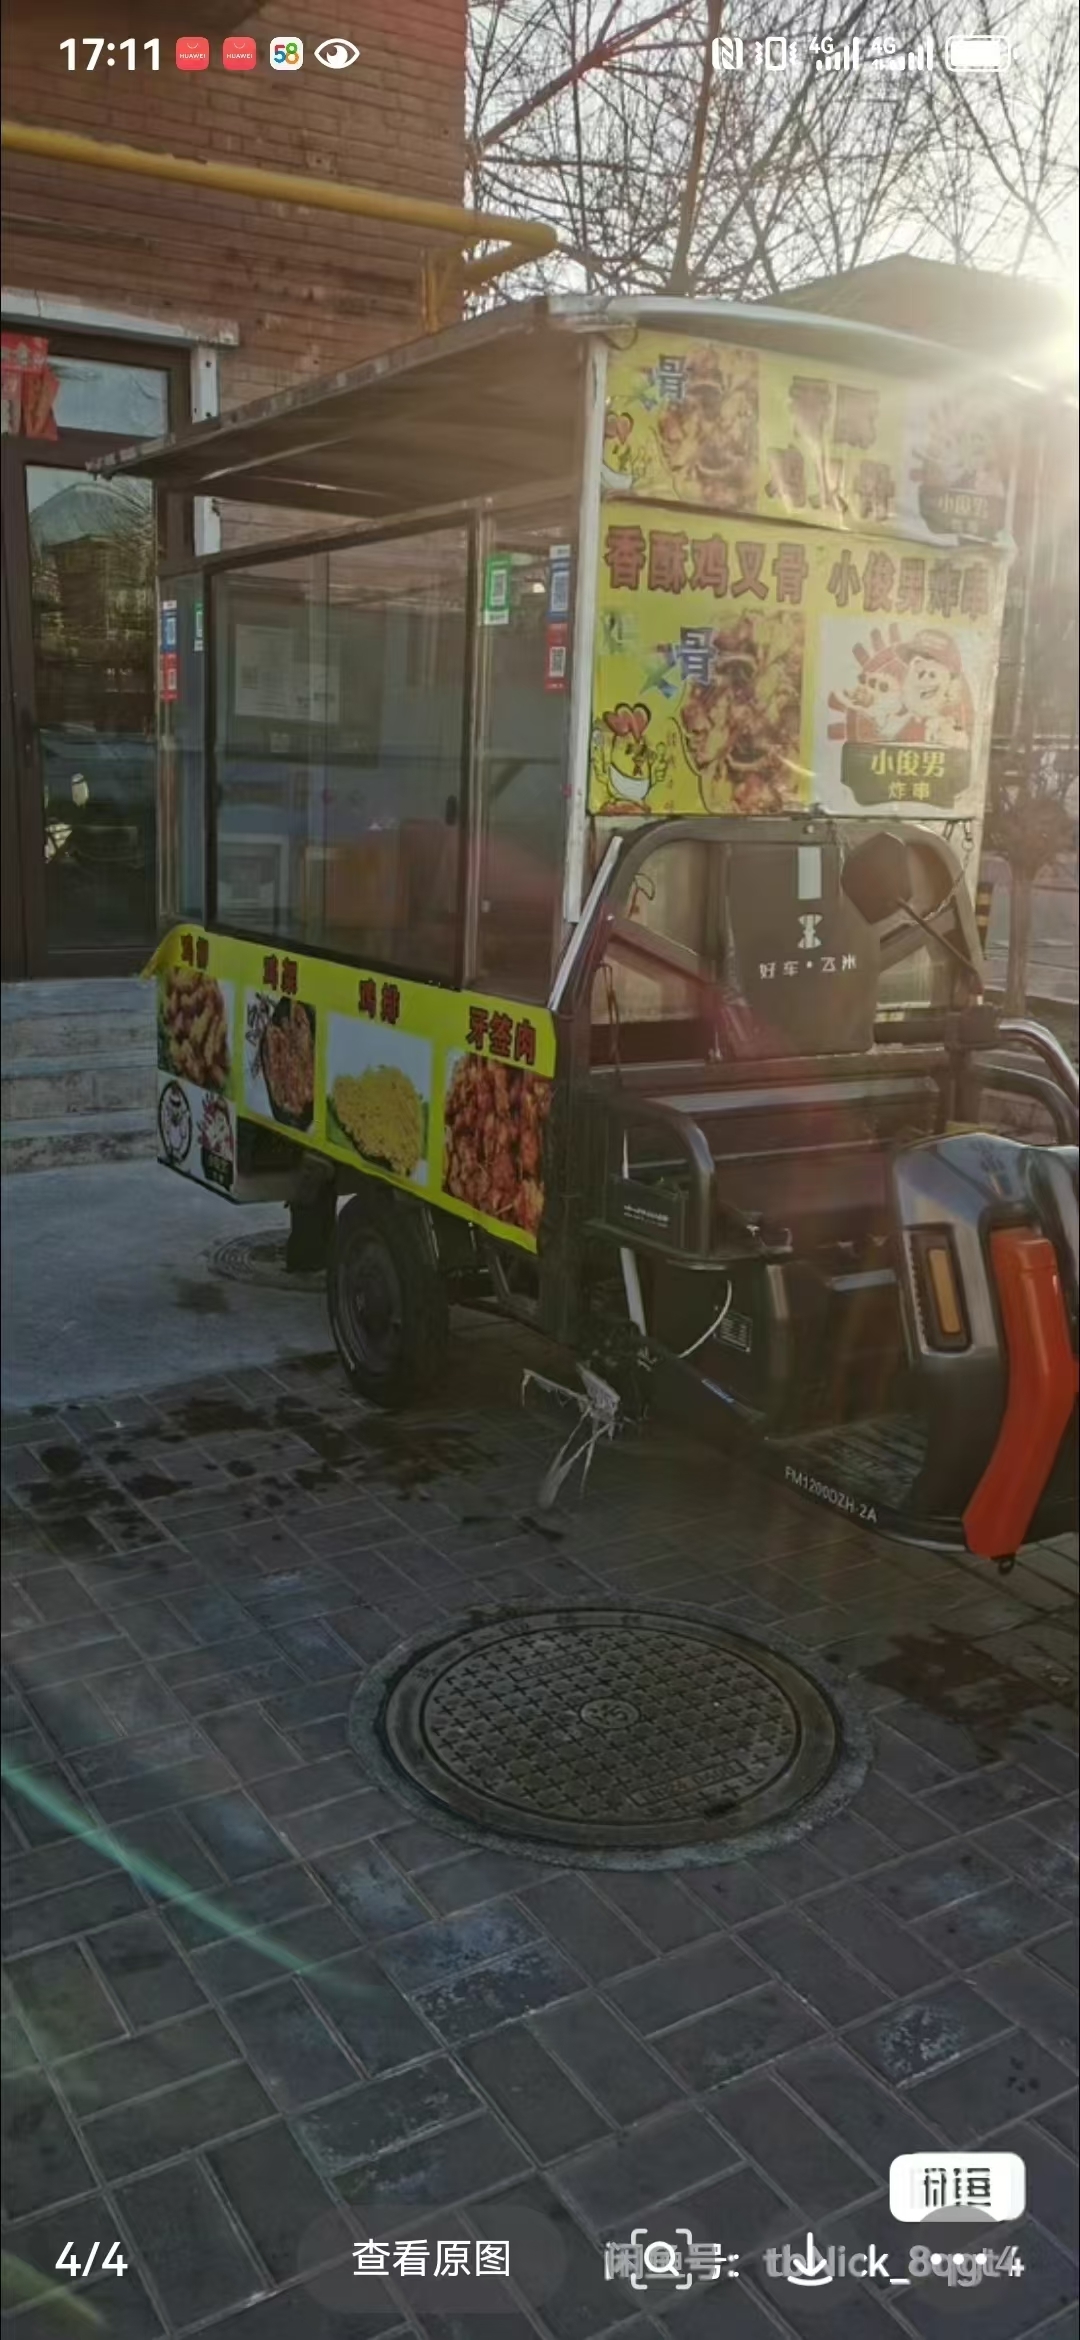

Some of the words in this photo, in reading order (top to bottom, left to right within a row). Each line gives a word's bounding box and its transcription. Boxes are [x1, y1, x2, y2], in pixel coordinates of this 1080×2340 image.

[870, 749, 946, 777] 小俊男
[465, 1005, 536, 1066] 牙签肉
